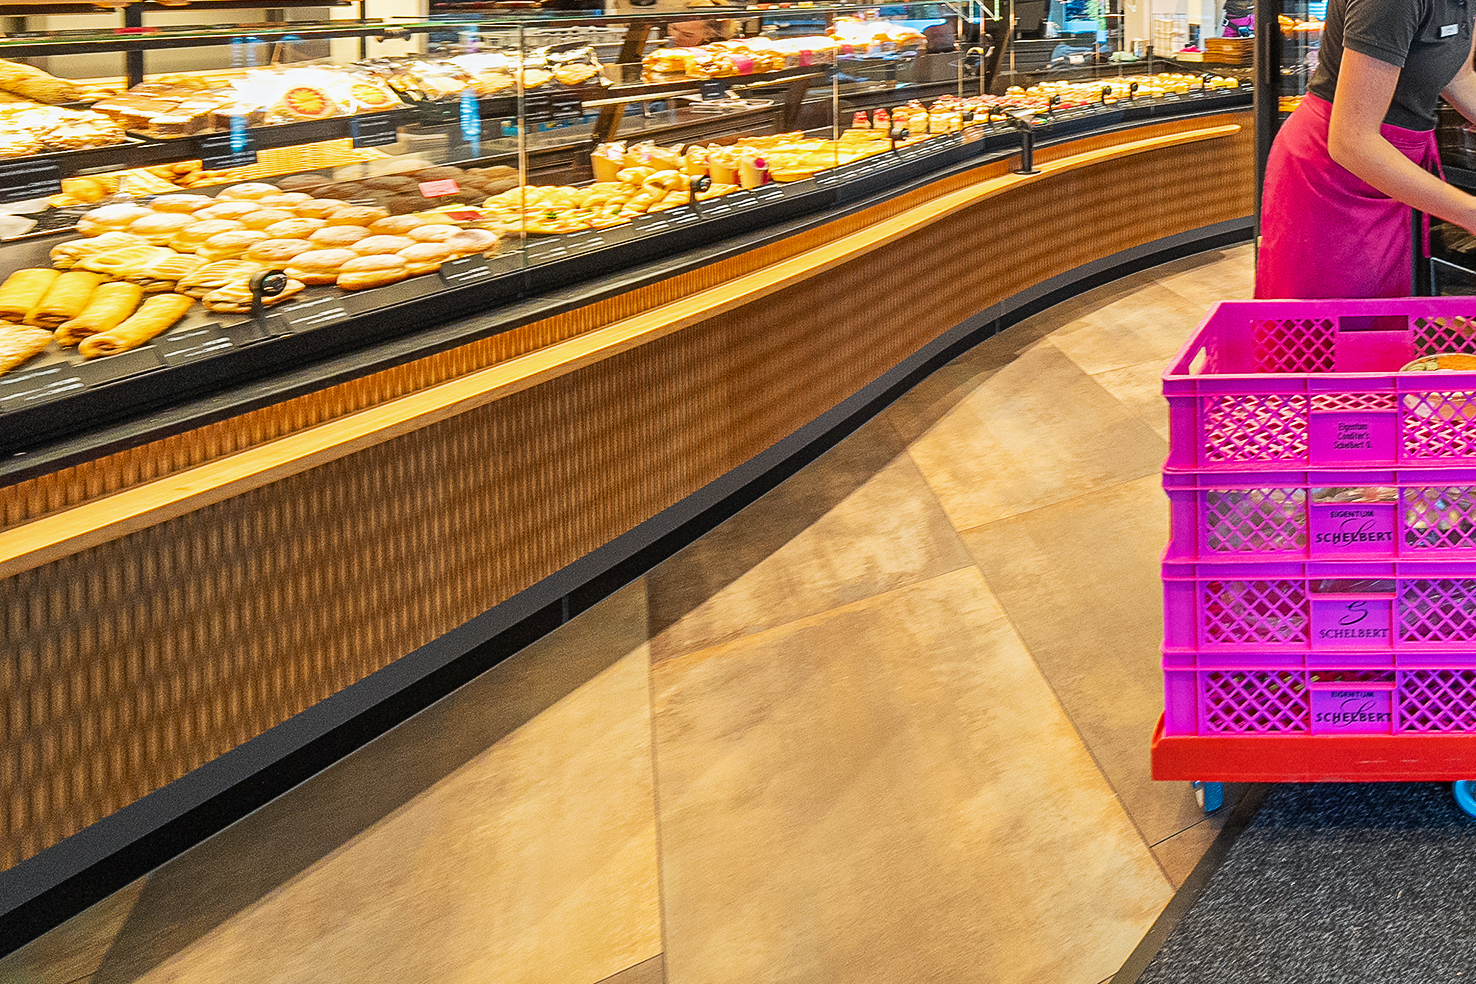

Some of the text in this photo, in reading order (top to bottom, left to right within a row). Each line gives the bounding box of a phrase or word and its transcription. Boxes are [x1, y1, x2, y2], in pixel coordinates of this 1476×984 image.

[1330, 510, 1375, 518] EIGENTUM
[1315, 531, 1393, 543] SCHELBERT
[1319, 628, 1389, 638] SCHELBERT
[1315, 712, 1392, 723] SCHELBERT
